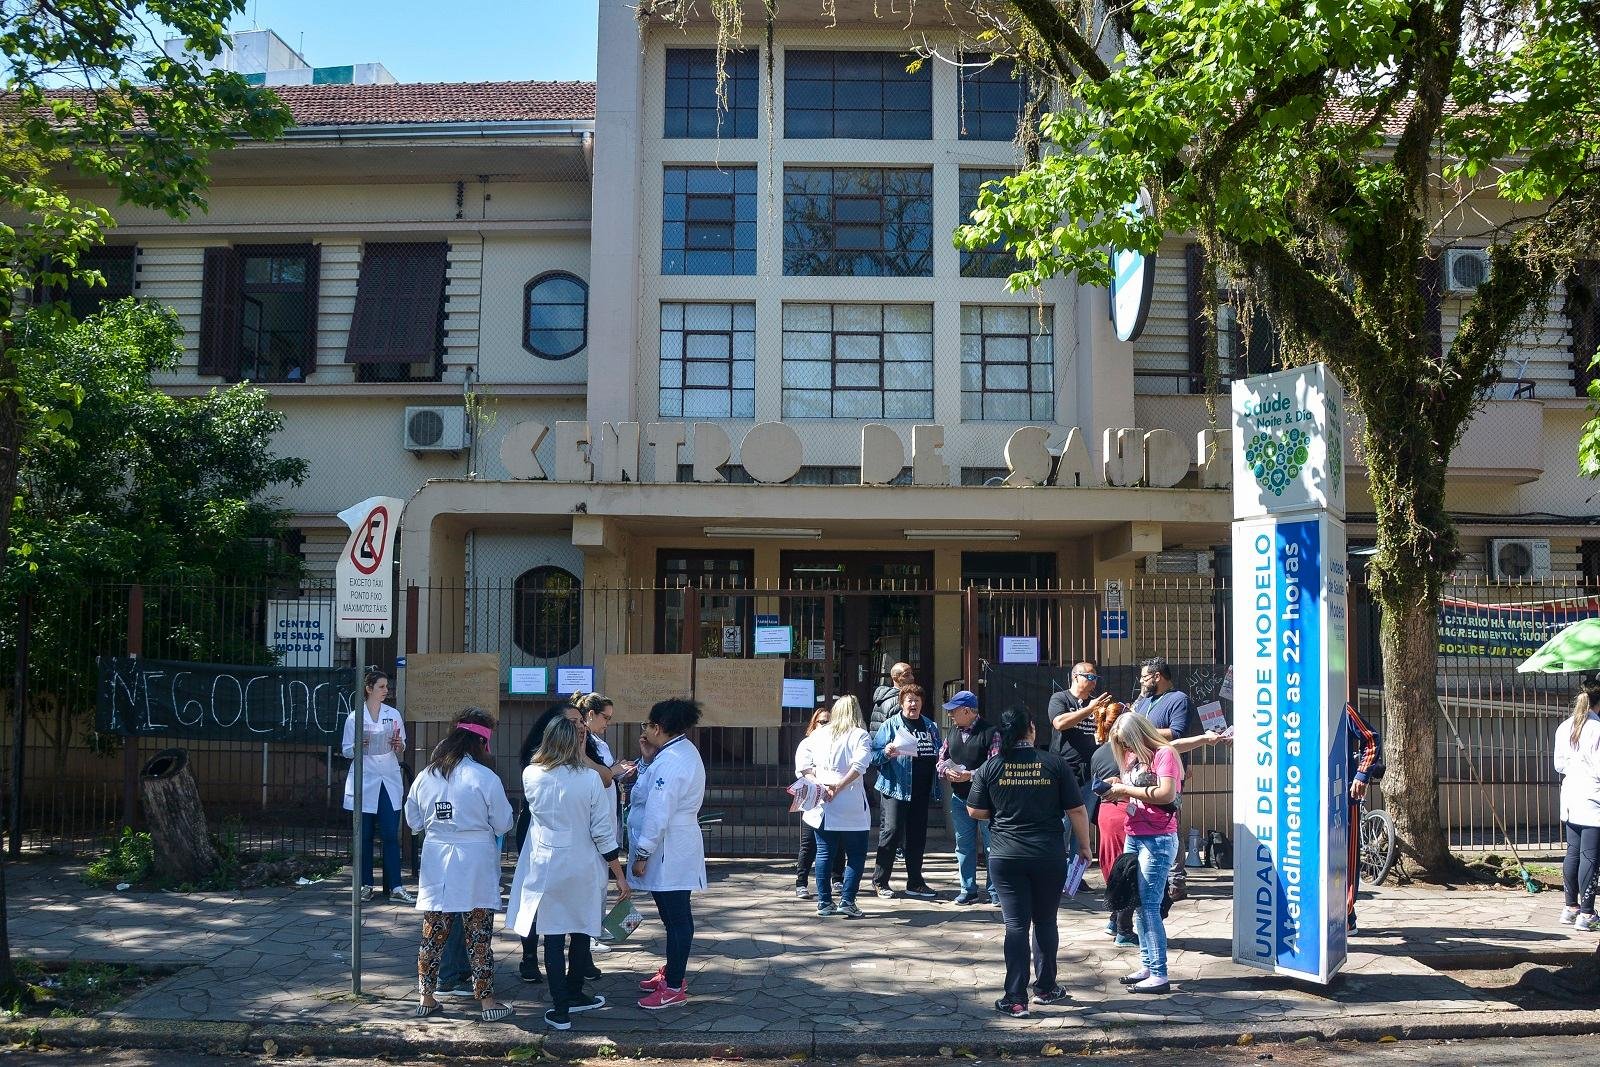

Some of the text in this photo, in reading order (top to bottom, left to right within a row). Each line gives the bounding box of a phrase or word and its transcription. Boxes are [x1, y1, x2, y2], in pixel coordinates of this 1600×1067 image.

[1244, 392, 1291, 417] Saúde
[1257, 414, 1282, 429] Noite
[1285, 412, 1293, 424] &
[500, 421, 802, 484] CENTRO
[861, 423, 950, 486] DE
[350, 578, 371, 587] EXCETO
[351, 591, 369, 600] PONTO
[279, 620, 320, 628] CENTRO
[355, 621, 375, 633] INÍCIO
[276, 644, 321, 652] MODELO
[1439, 643, 1485, 655] ROCURE
[1252, 534, 1273, 958] UNIDADE DE SAÚDE MODELO
[1282, 542, 1301, 959] Atendimento até as 22 horas
